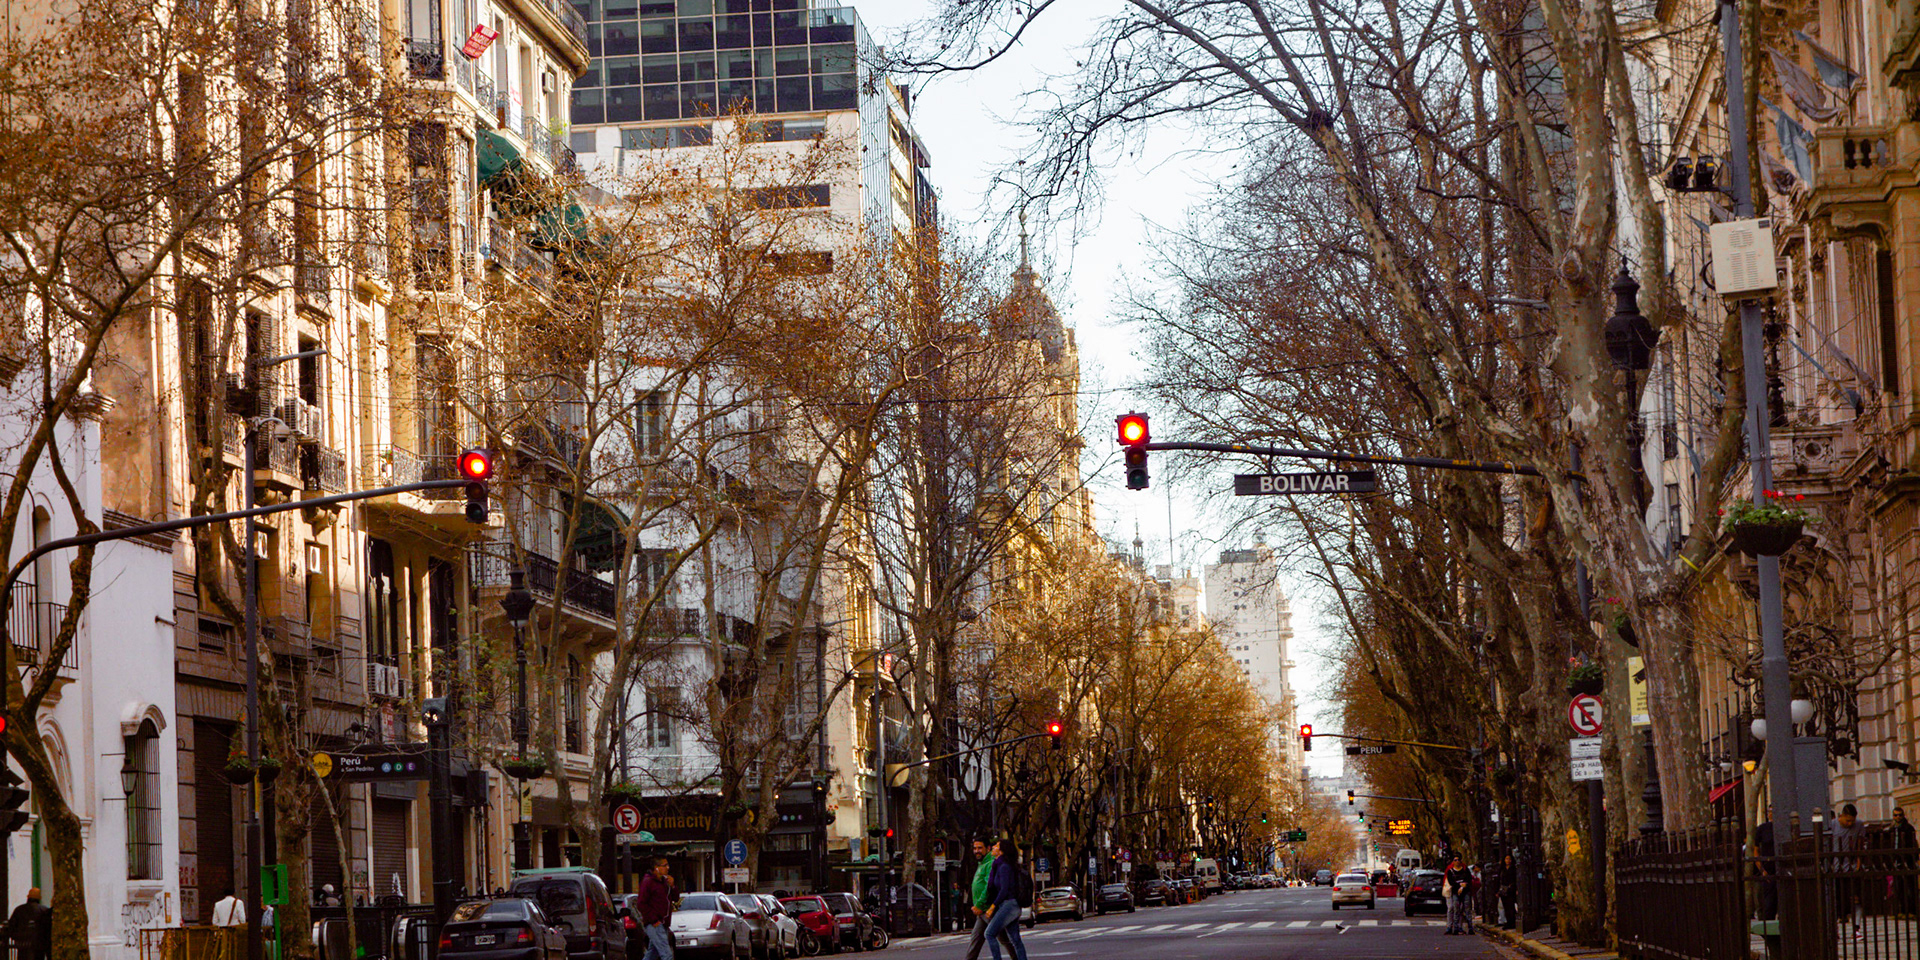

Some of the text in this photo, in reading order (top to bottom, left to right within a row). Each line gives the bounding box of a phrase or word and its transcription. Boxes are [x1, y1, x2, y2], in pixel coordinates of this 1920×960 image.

[1260, 474, 1350, 492] BOLIVAR
[1360, 746, 1383, 754] PERU
[340, 756, 361, 766] Perú
[731, 841, 741, 854] E
